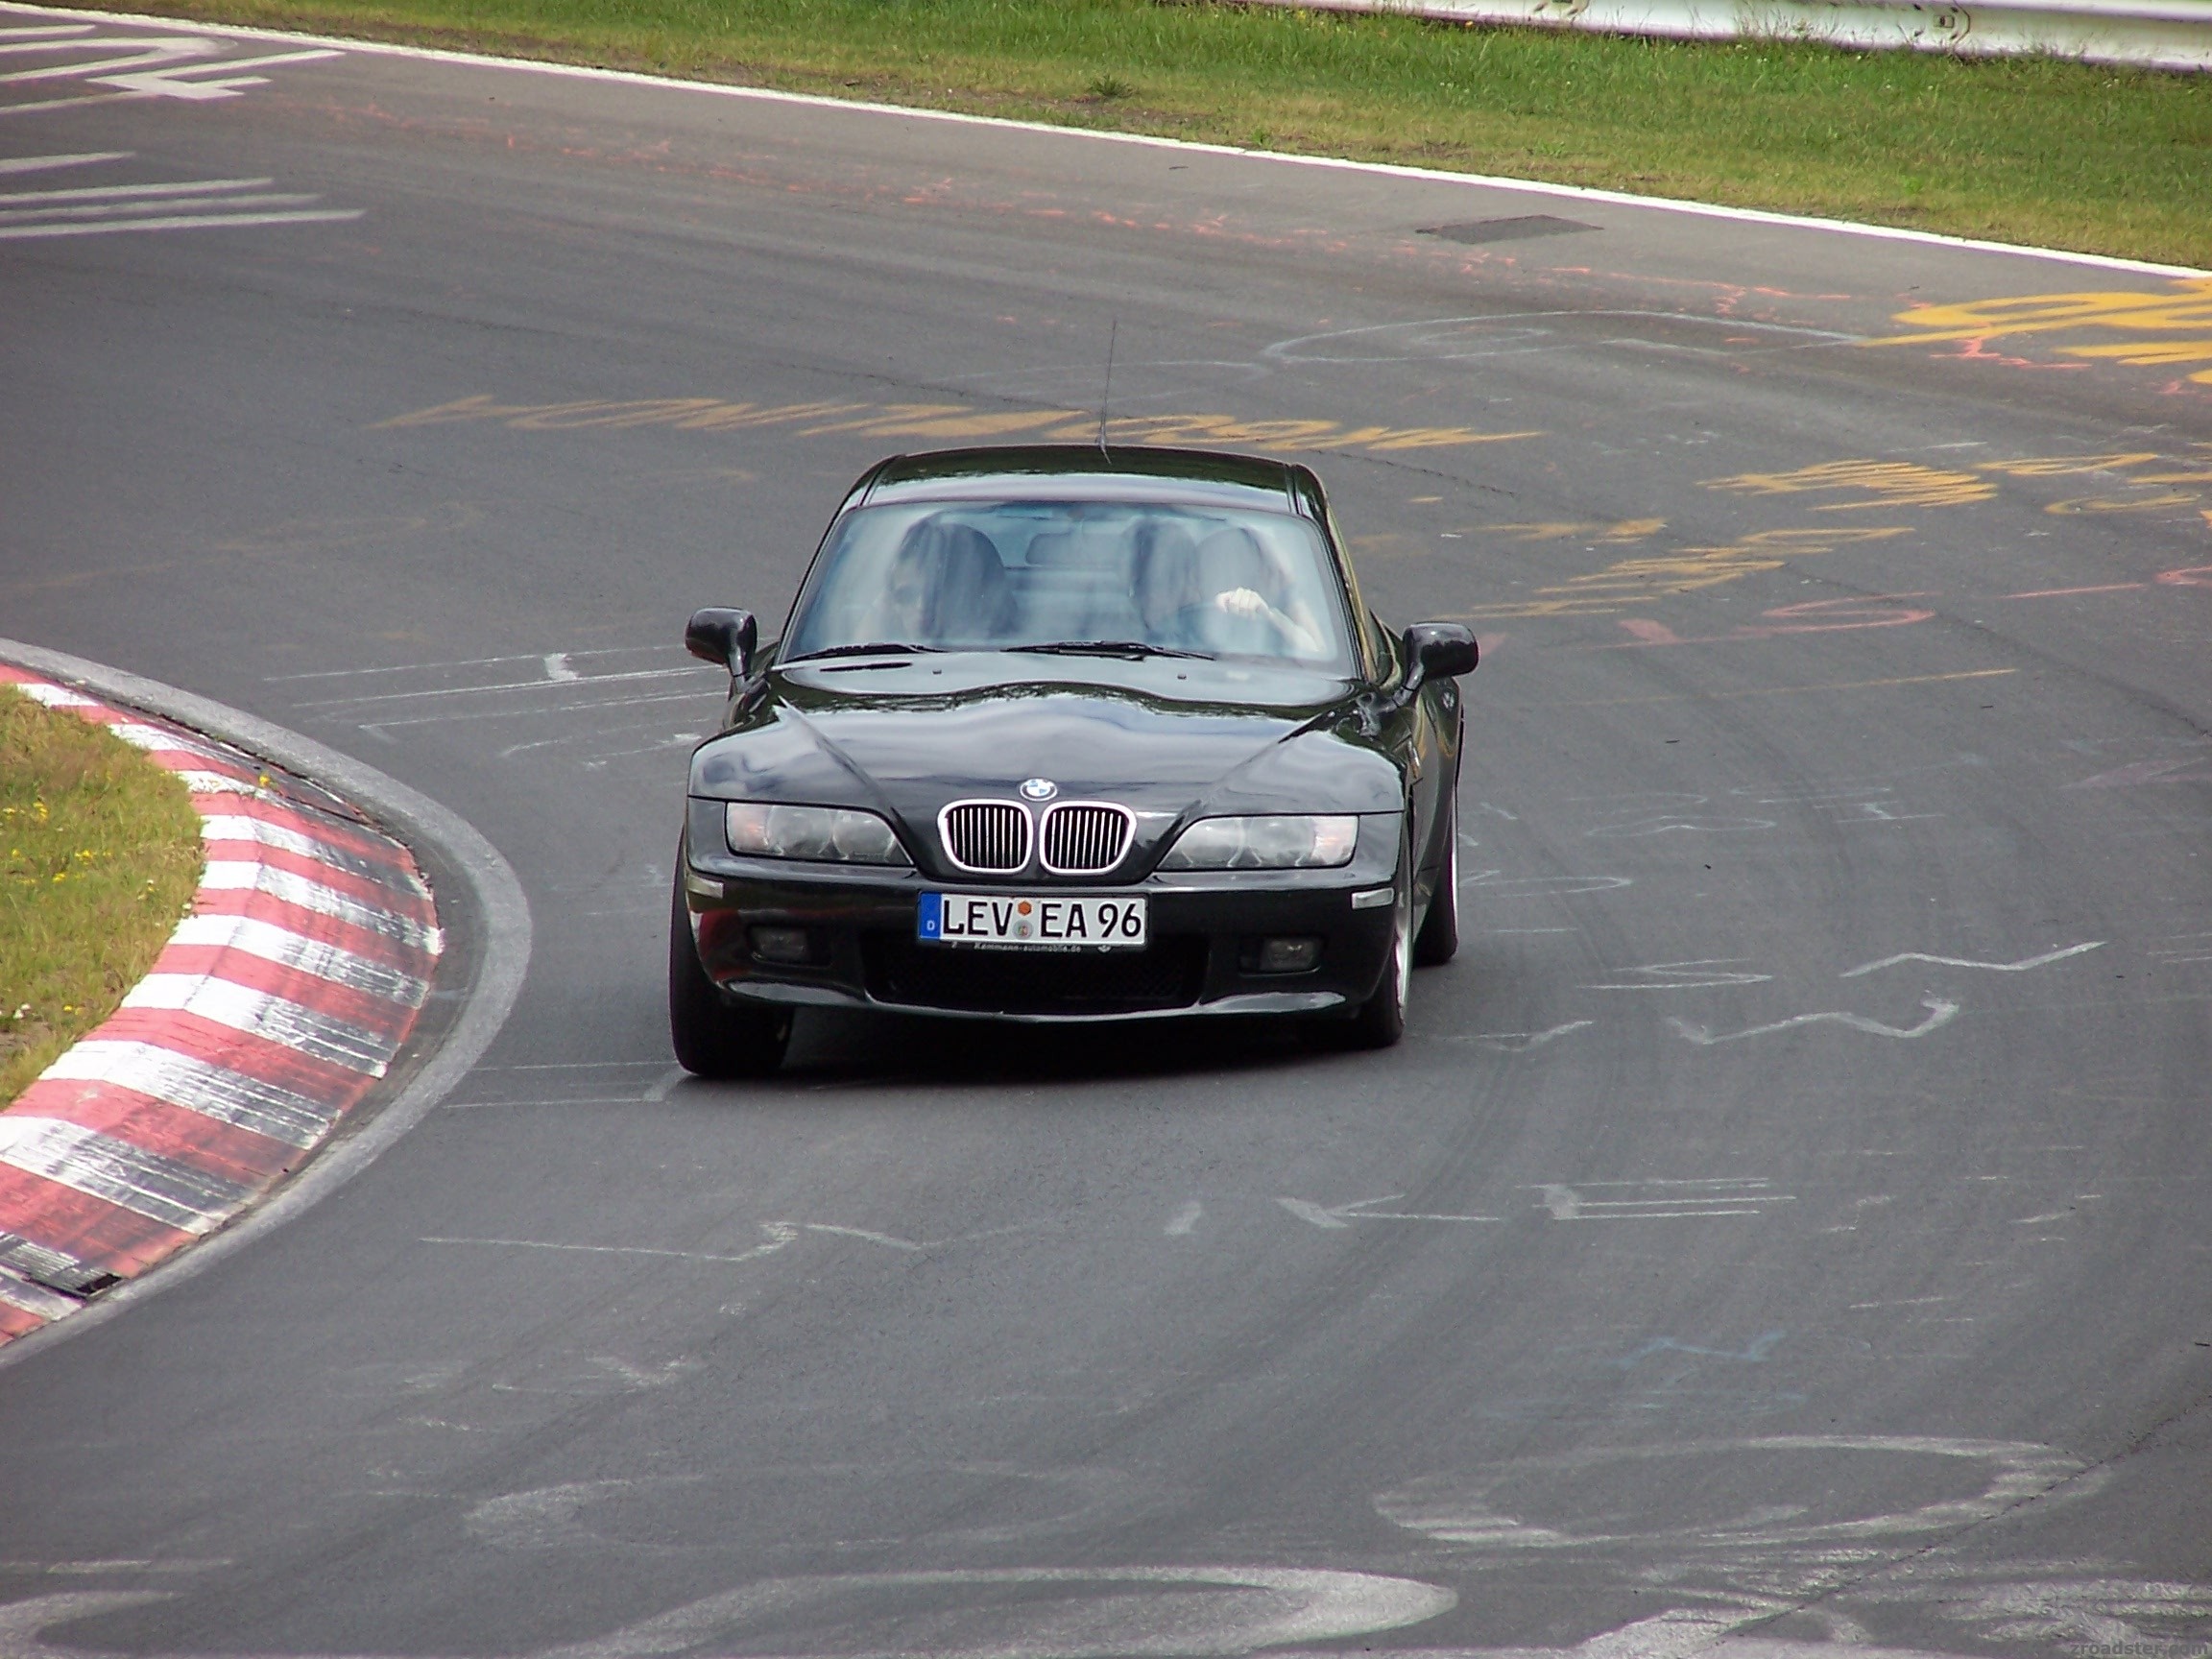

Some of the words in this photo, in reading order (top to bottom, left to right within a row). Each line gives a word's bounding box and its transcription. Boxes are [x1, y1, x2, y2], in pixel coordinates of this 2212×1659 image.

[926, 921, 935, 931] D
[943, 900, 1013, 936] LEV
[1041, 902, 1087, 938] EA
[1098, 902, 1142, 938] 96
